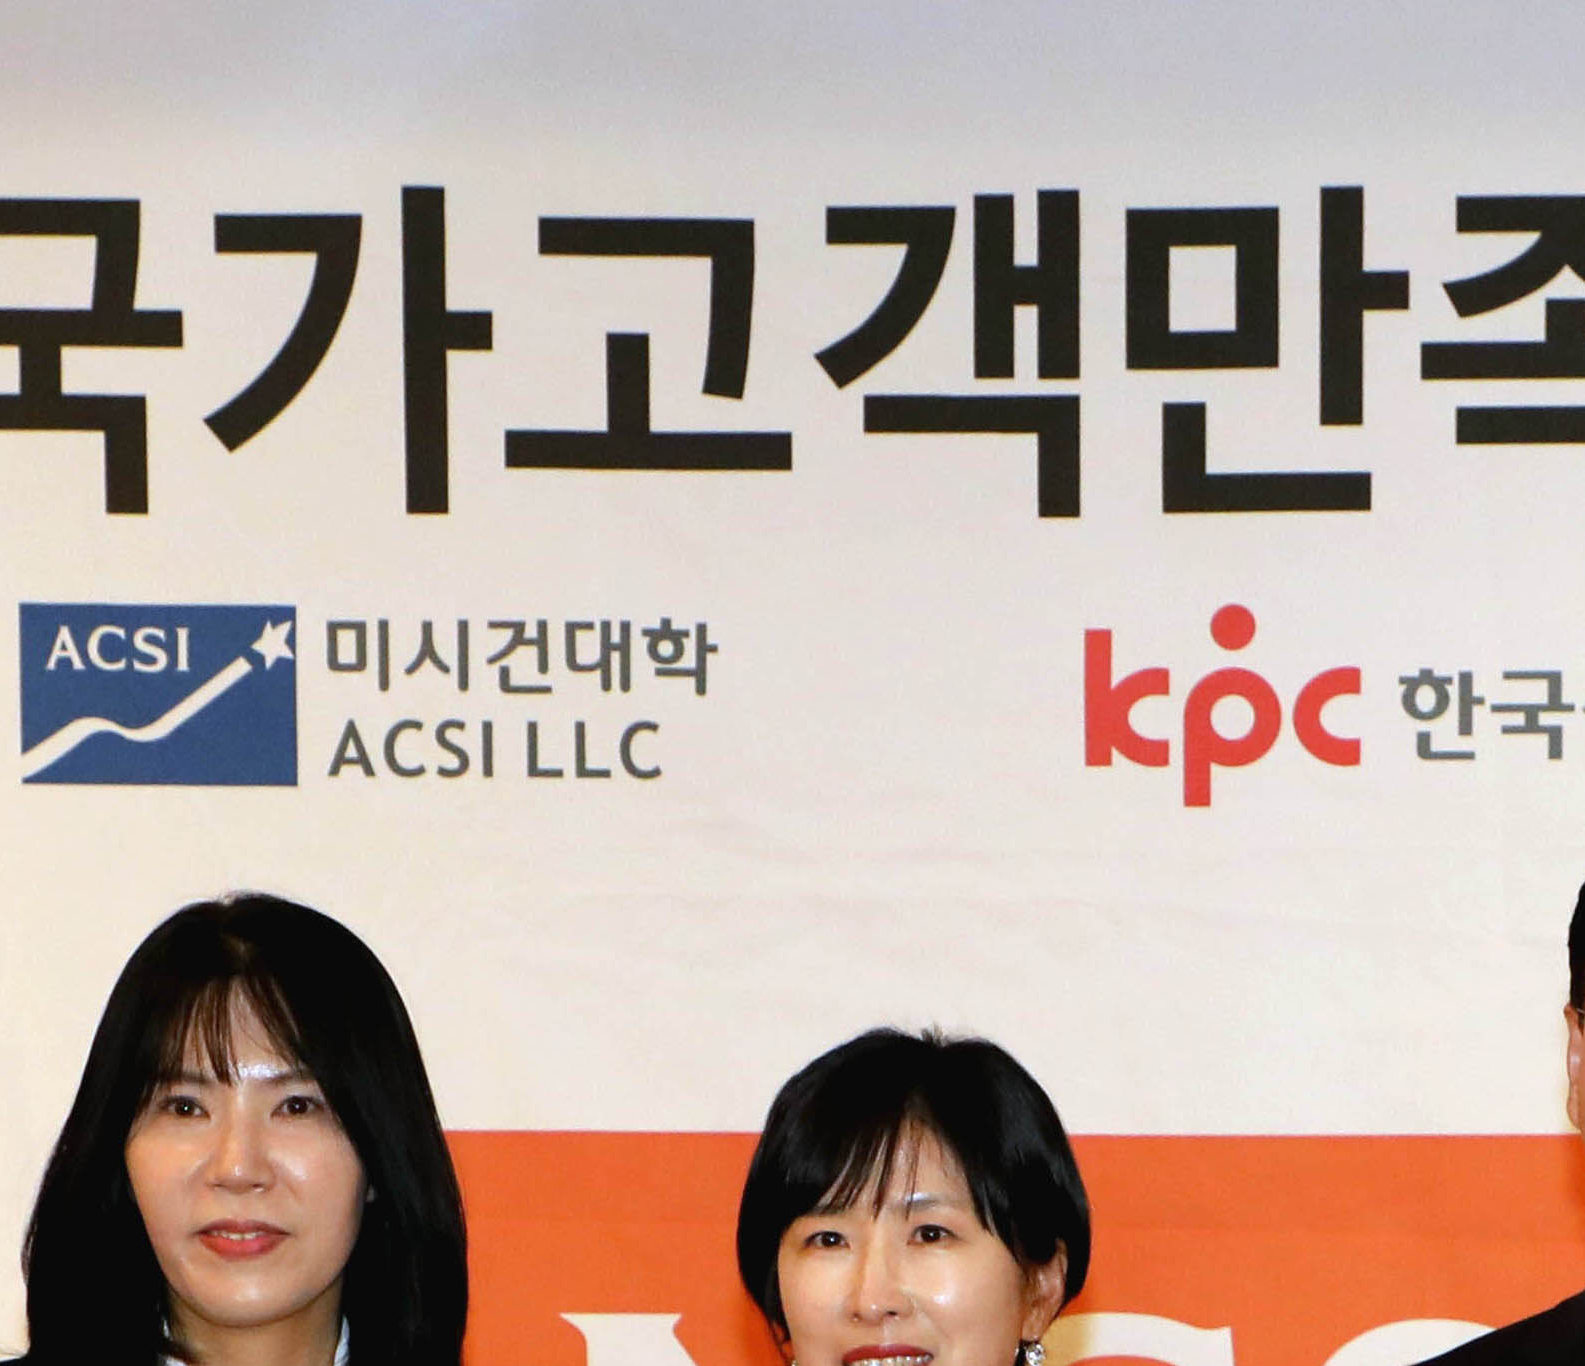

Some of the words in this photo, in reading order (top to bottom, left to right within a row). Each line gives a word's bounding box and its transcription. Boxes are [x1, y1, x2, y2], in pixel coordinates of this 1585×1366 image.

[45, 625, 191, 676] ACSI
[325, 617, 721, 698] 미시건대학
[1083, 602, 1364, 811] kpc
[327, 718, 498, 781] ACSI
[525, 720, 666, 782] LLC
